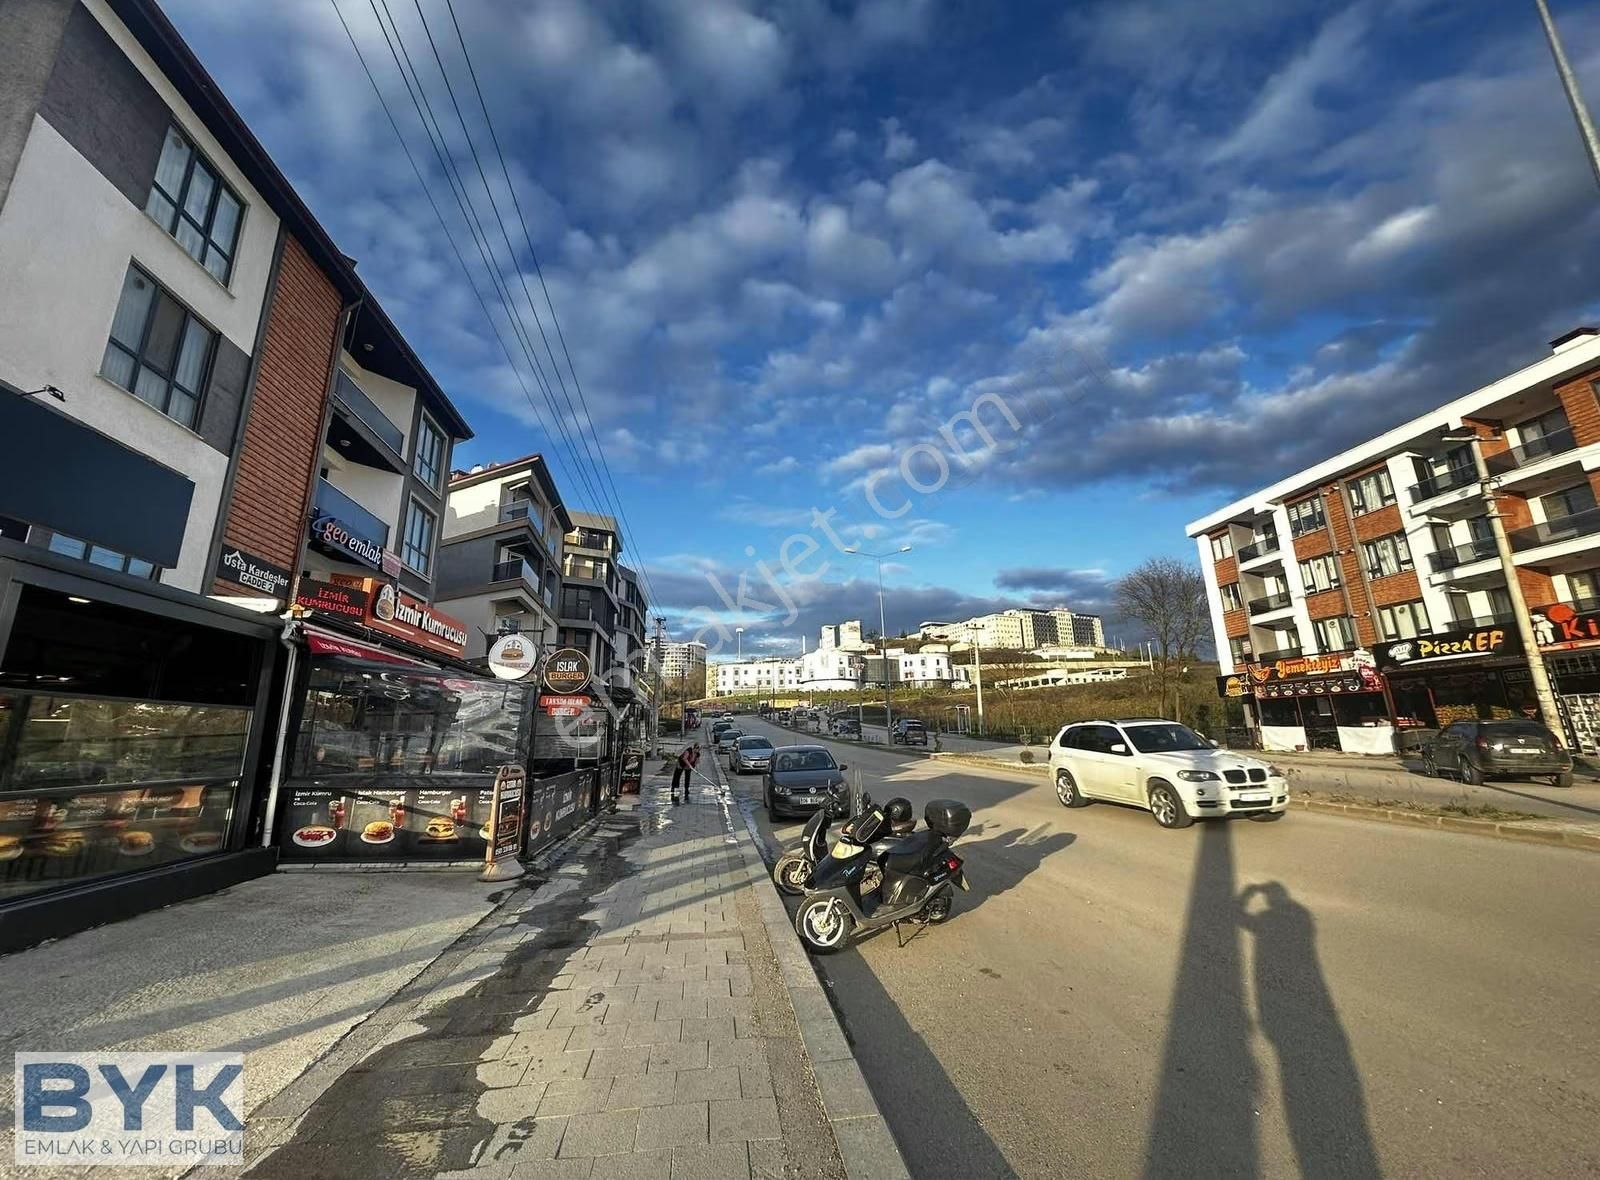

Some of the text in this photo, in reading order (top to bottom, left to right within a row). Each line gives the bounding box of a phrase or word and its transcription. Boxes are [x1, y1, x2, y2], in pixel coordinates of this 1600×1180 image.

[323, 522, 349, 542] geo
[348, 536, 383, 565] emlak
[224, 552, 248, 571] Usta
[241, 573, 267, 588] CADDE
[318, 587, 350, 604] İZMİR
[297, 596, 364, 617] KUMRUCUSU
[395, 592, 468, 647] İzmir Kumrucusu
[556, 660, 578, 672] ISLAK
[1276, 655, 1341, 679] Yemekteyiz
[548, 672, 585, 681] BURGER
